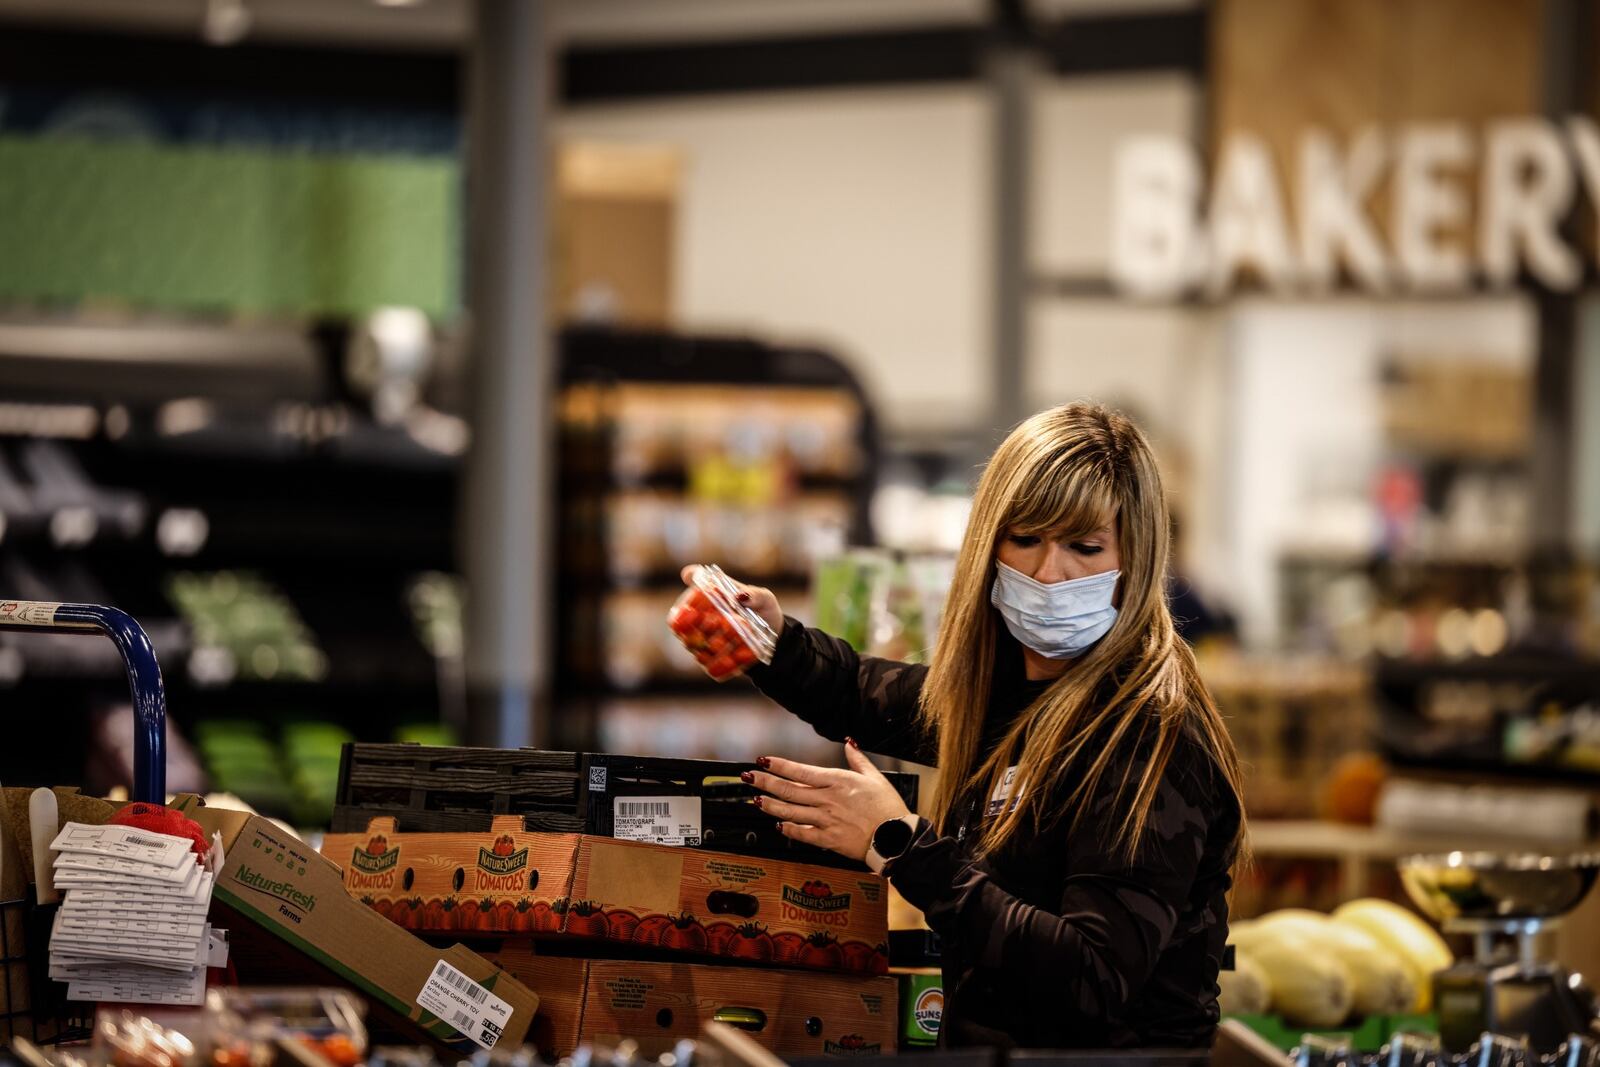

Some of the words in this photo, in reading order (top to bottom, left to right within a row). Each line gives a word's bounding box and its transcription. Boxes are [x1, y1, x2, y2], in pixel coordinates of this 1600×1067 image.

[690, 837, 699, 846] 52
[480, 852, 526, 871] NATURESWEET
[235, 864, 316, 912] NatureFresh
[350, 868, 395, 889] TOMATOES
[475, 869, 526, 891] TOMATOES
[279, 904, 302, 924] Farms
[781, 902, 849, 926] TOMATOES
[429, 979, 451, 996] ORANGE
[448, 992, 469, 1007] CHERRY
